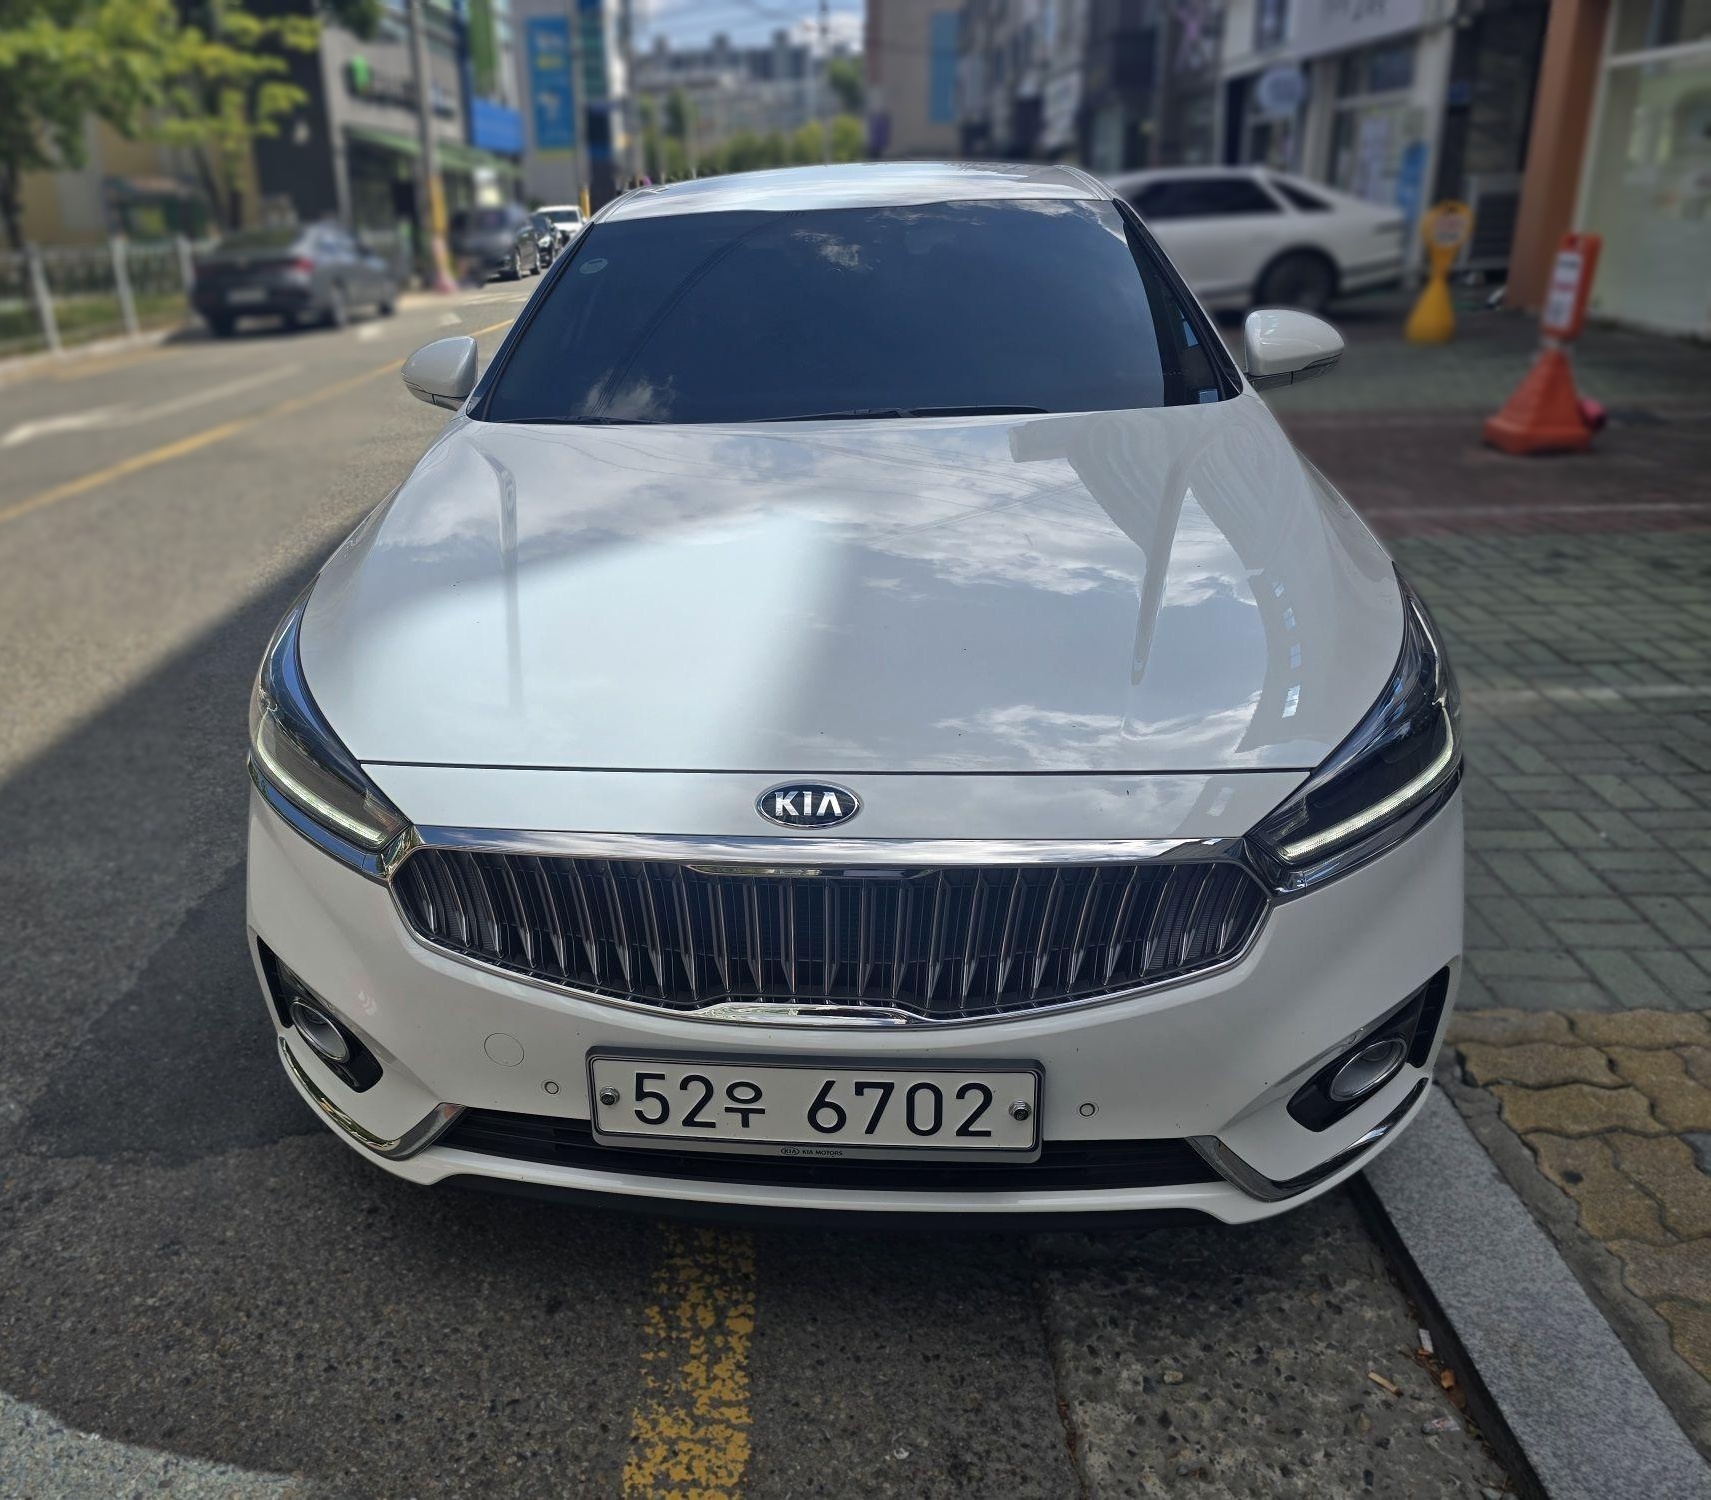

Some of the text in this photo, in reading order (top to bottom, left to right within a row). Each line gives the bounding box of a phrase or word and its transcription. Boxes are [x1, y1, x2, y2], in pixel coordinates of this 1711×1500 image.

[774, 791, 843, 816] KIA
[634, 1072, 993, 1137] 52우 6702
